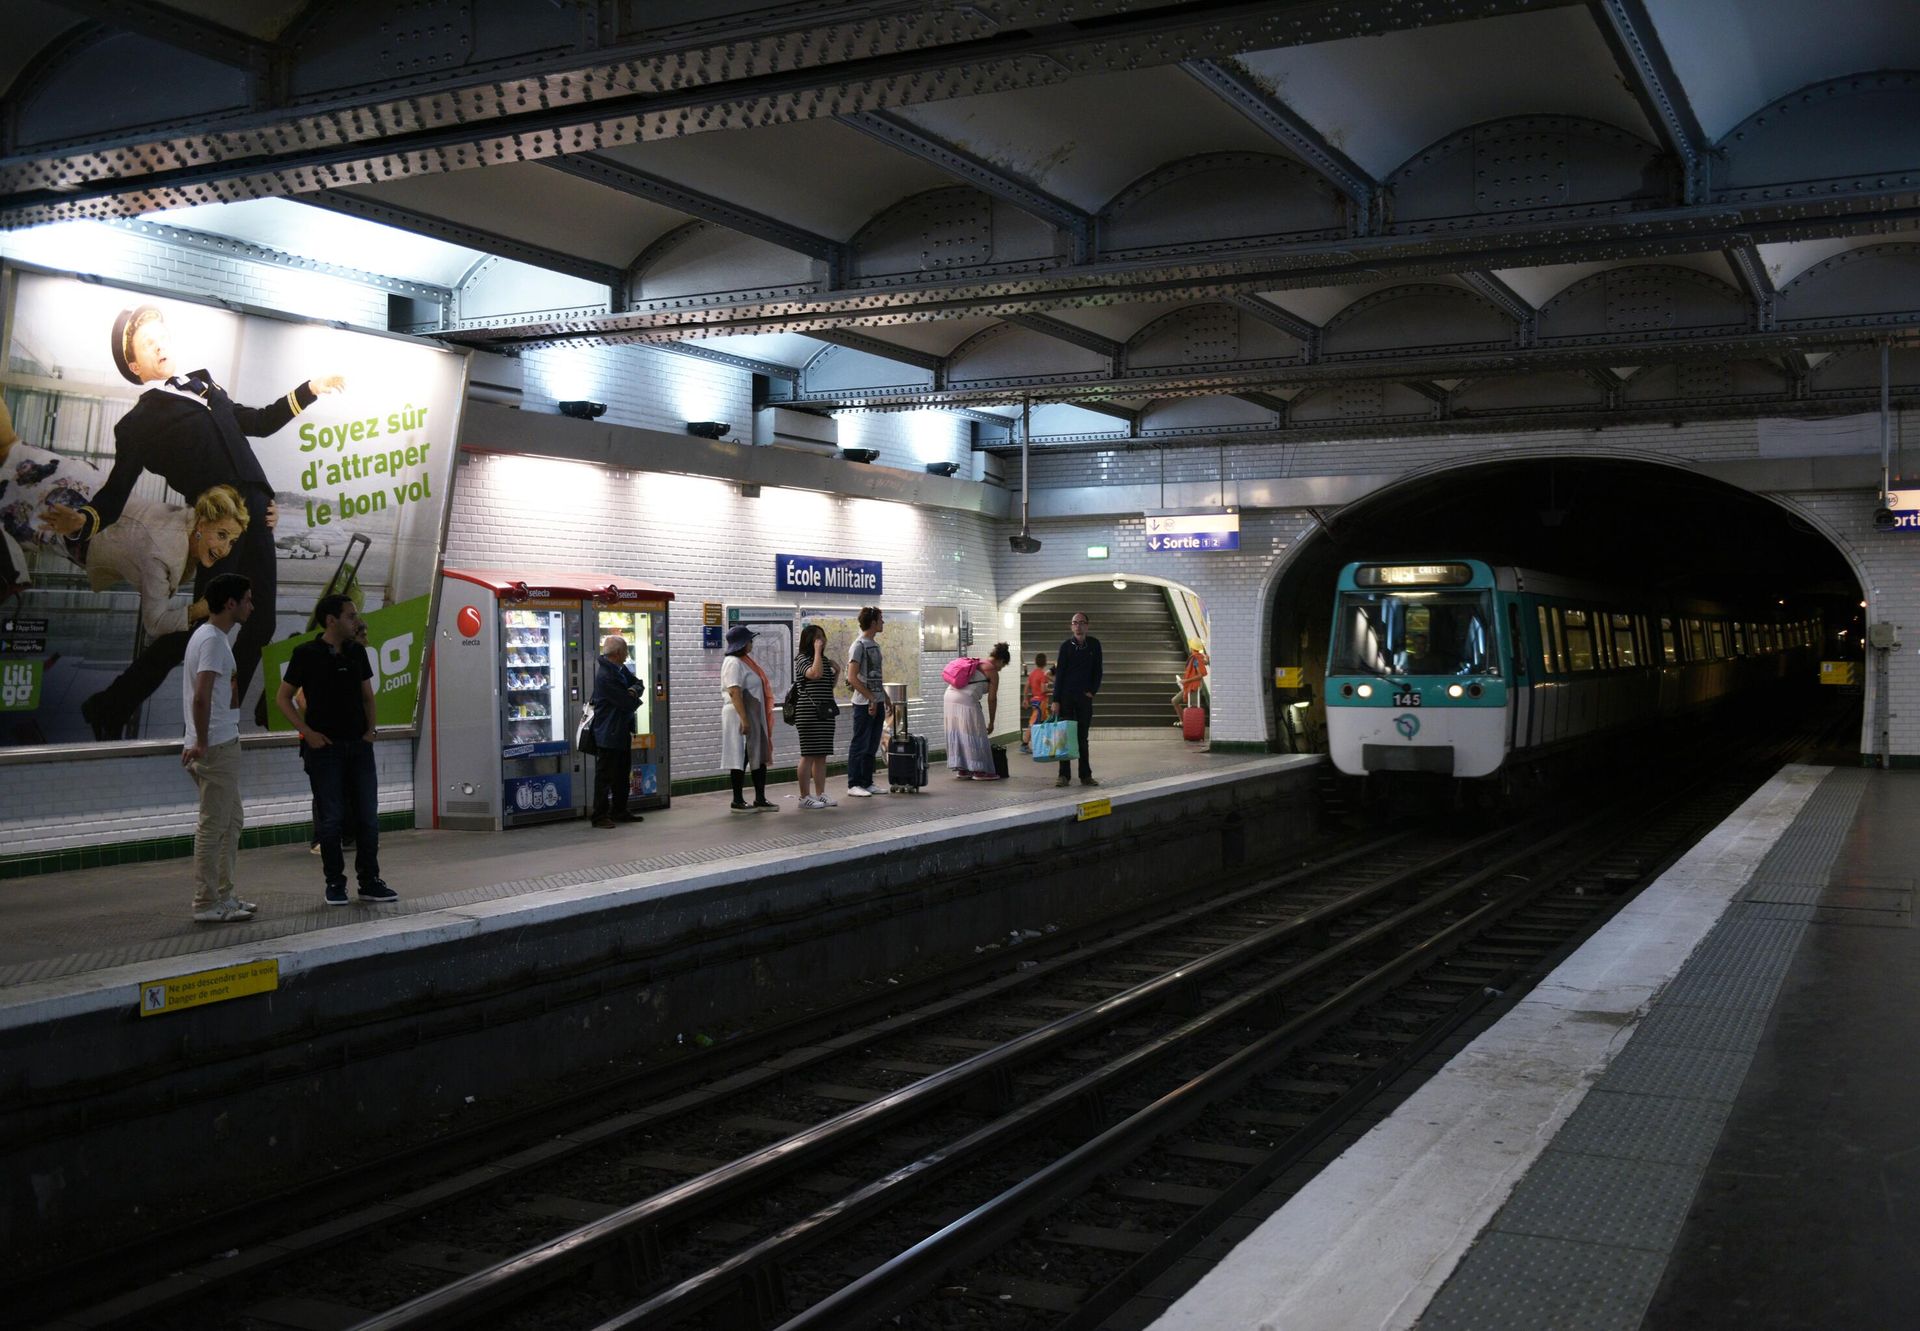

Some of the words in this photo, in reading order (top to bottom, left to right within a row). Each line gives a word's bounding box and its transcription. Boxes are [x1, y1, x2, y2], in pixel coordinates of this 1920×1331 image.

[299, 418, 380, 452] Soyez
[387, 403, 428, 434] sûr
[301, 443, 431, 491] d'attraper
[305, 499, 332, 528] le
[338, 490, 387, 520] bon
[393, 472, 432, 506] vol
[1893, 511, 1920, 528] orti
[1163, 536, 1200, 549] Sortie
[786, 559, 821, 587] École
[824, 566, 876, 589] Militaire
[528, 588, 551, 598] selecta
[618, 590, 638, 599] selecta
[12, 644, 31, 652] Google
[382, 671, 412, 693] .com
[1393, 694, 1421, 706] 145
[168, 984, 180, 993] Ne
[182, 983, 196, 992] pas
[197, 972, 236, 988] descendre
[238, 971, 249, 980] sur
[251, 968, 258, 976] la
[259, 966, 274, 976] voie
[168, 993, 197, 1005] Danger
[198, 989, 208, 998] de
[209, 986, 230, 997] mort
